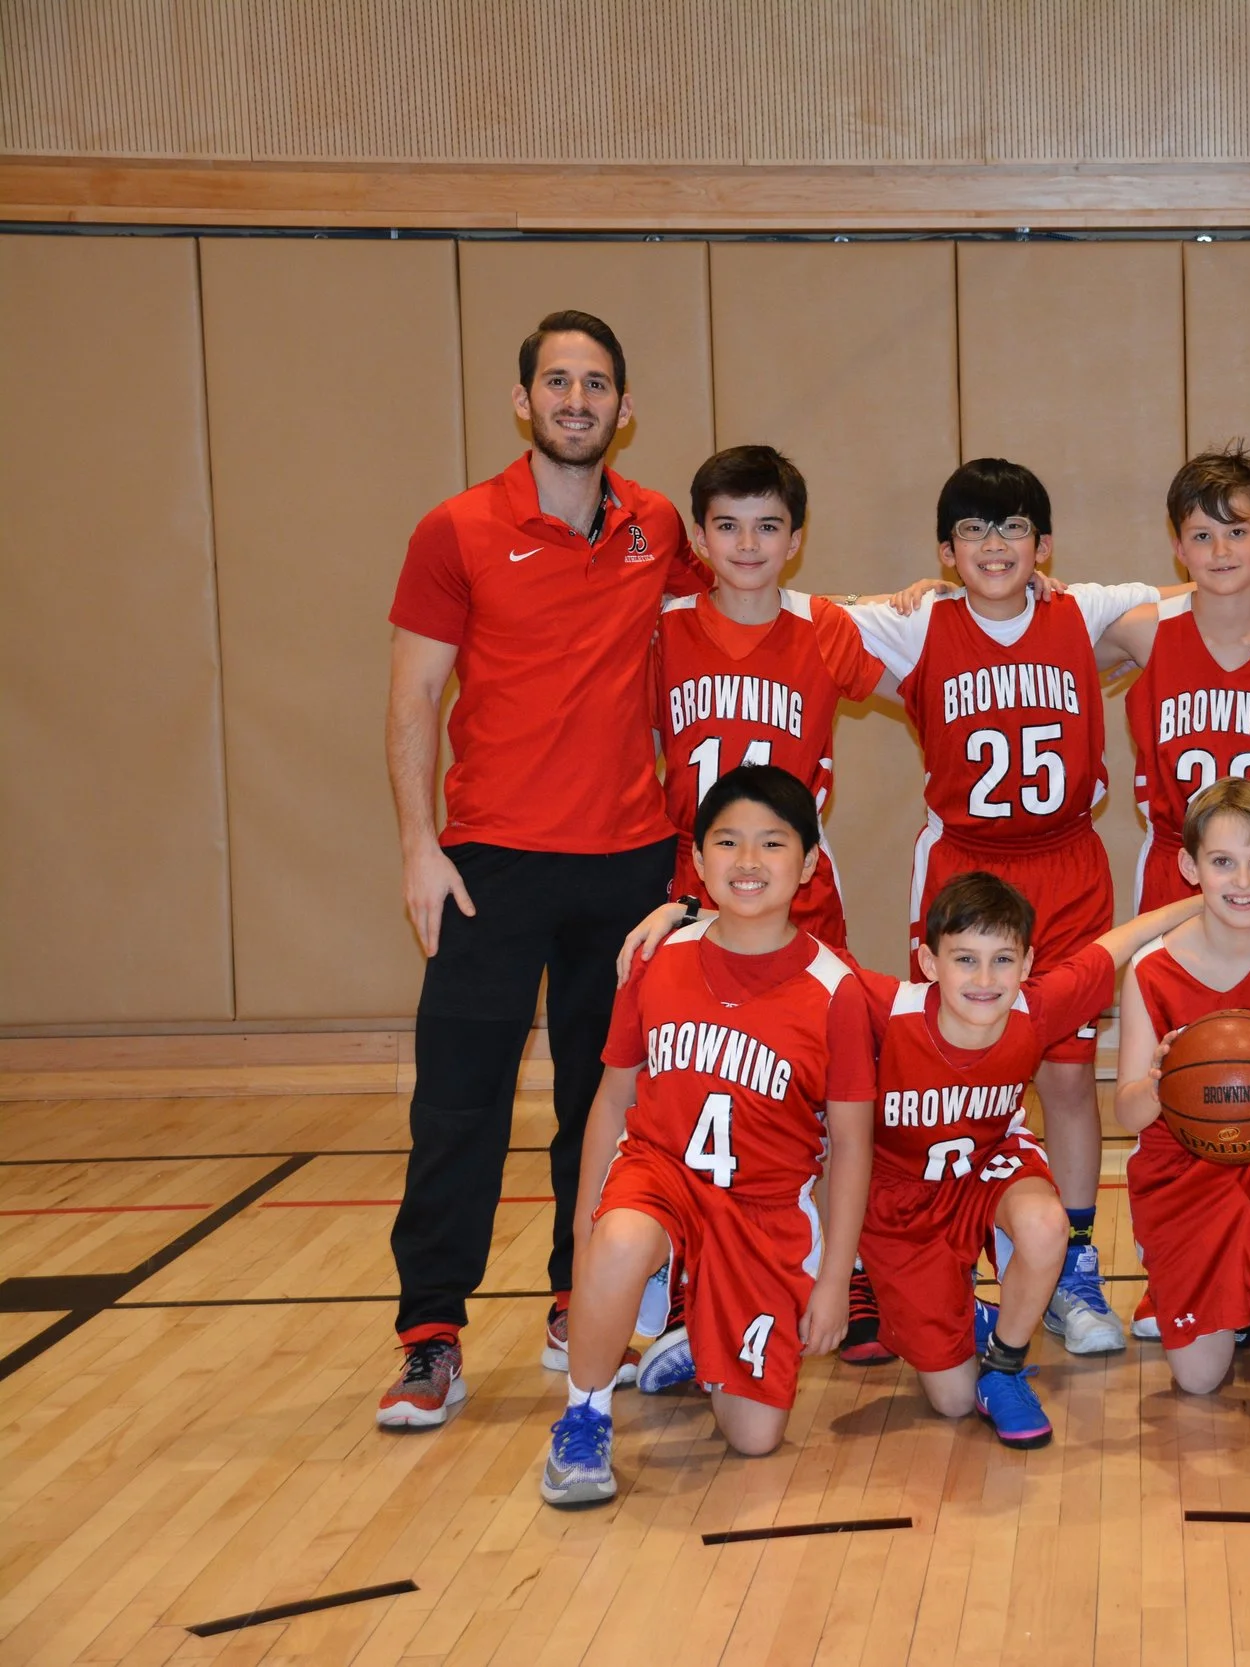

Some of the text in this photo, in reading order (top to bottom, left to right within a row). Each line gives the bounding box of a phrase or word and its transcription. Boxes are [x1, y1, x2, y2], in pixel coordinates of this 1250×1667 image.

[669, 674, 803, 739] BROWNING
[943, 663, 1080, 725] BROWNING
[688, 736, 772, 808] 1
[966, 721, 1067, 818] 25
[647, 1020, 793, 1101] BROWNING
[683, 1091, 738, 1188] 4
[884, 1082, 1025, 1128] BROWNING
[738, 1312, 776, 1379] 4
